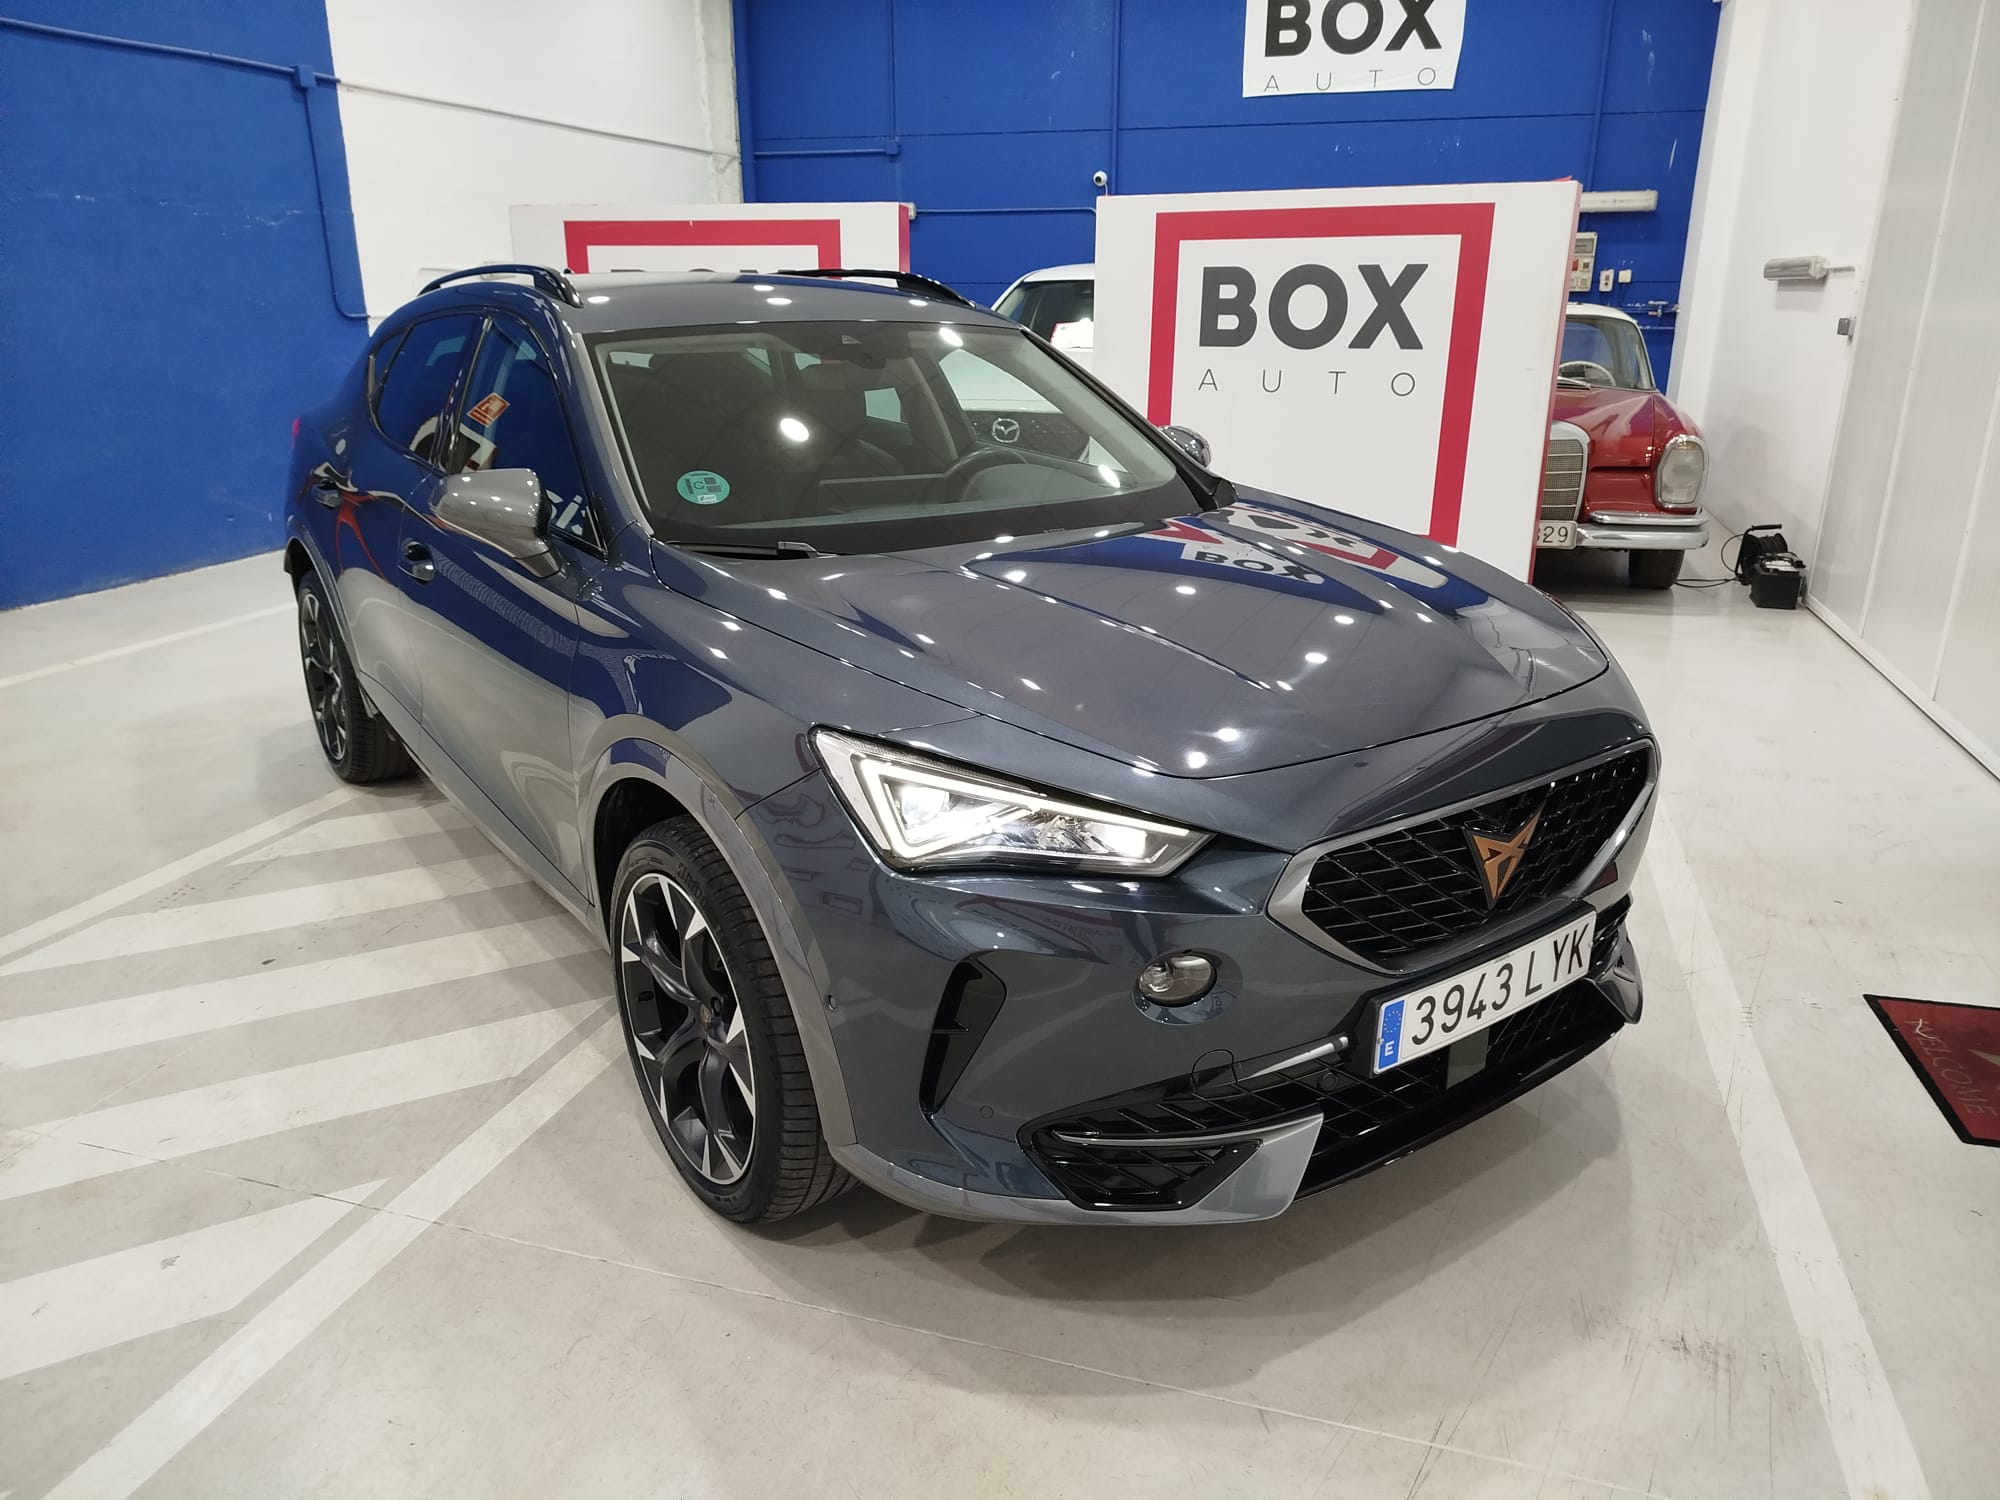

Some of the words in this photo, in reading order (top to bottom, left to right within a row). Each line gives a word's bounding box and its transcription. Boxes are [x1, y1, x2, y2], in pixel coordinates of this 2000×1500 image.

[1264, 0, 1442, 57] BOX
[1264, 67, 1437, 92] AUTO
[1199, 263, 1429, 350] BOX
[1197, 368, 1416, 397] AUTO
[1411, 963, 1515, 1046] 3943
[1525, 923, 1590, 997] LYK
[1384, 1040, 1395, 1056] E
[1903, 1018, 1999, 1117] WELCOME
